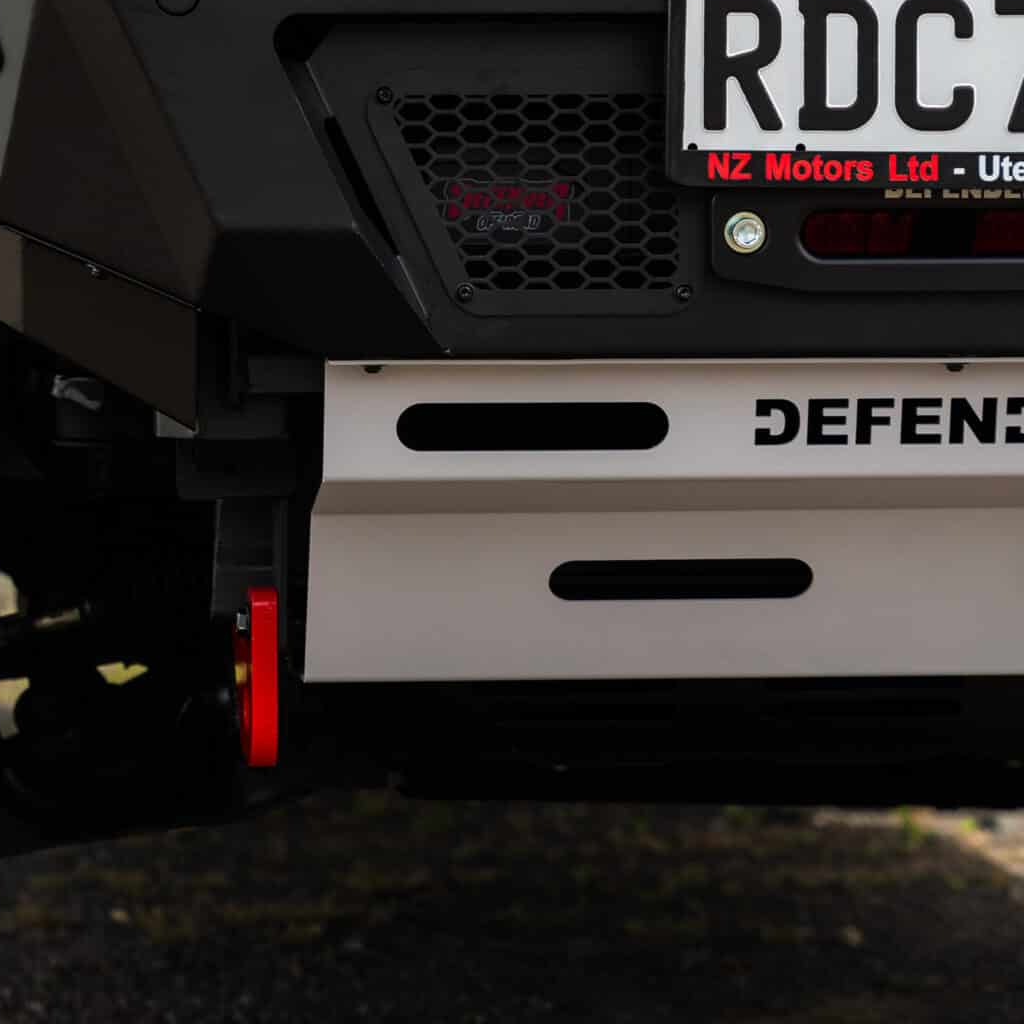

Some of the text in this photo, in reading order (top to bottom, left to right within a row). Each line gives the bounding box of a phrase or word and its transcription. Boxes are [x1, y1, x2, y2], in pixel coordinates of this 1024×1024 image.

[707, 152, 753, 181] NZ
[765, 152, 875, 182] Motors
[888, 153, 940, 182] Ltd
